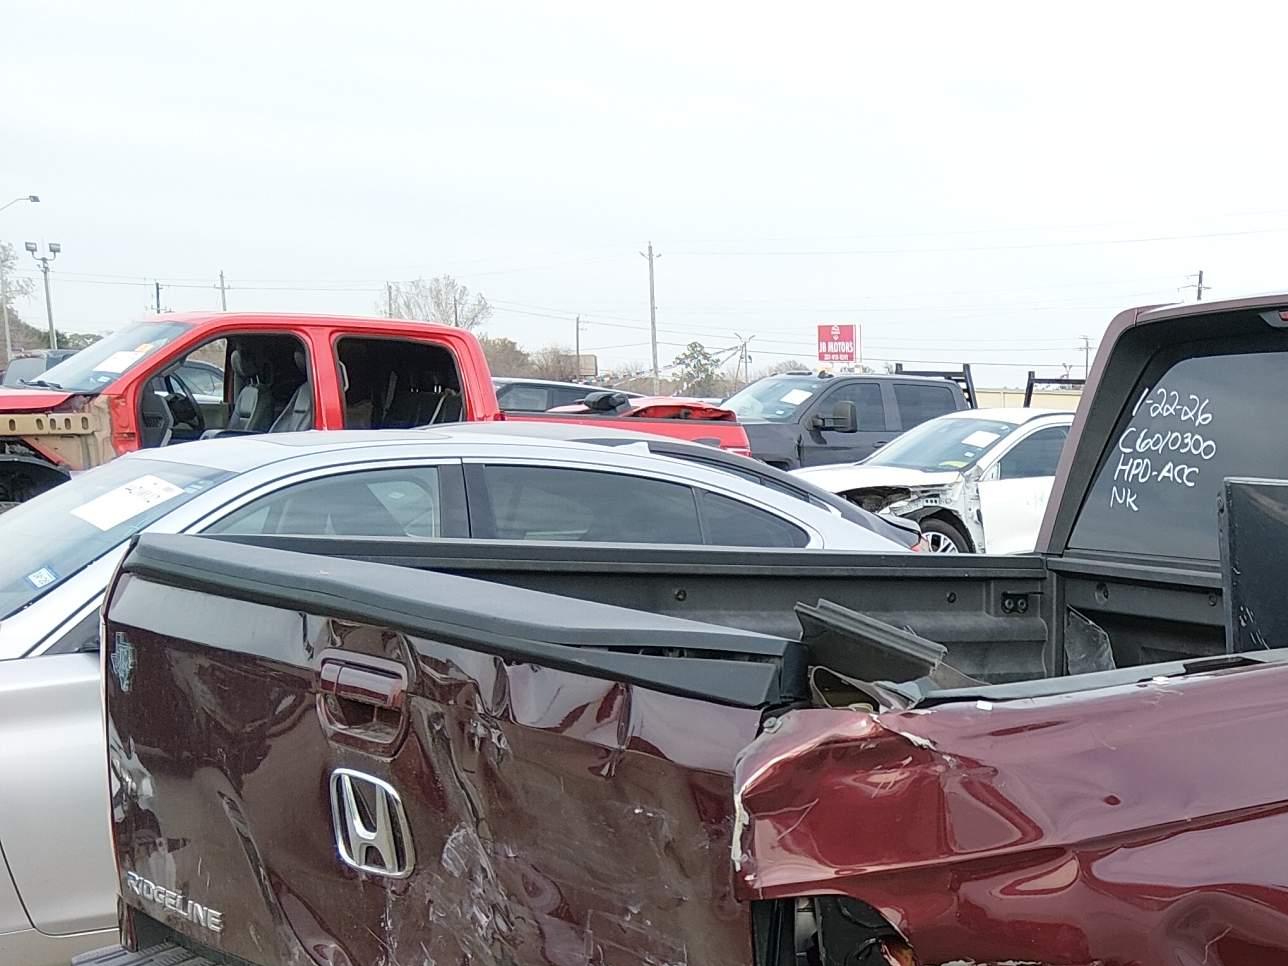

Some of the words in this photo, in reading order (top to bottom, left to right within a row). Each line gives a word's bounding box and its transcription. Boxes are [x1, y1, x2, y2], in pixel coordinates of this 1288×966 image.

[827, 341, 854, 353] MOTORS
[1132, 388, 1212, 427] 1-22-26
[1113, 453, 1199, 487] HPD-ACC
[1110, 485, 1139, 511] NK
[127, 870, 225, 933] RIDGELINE
